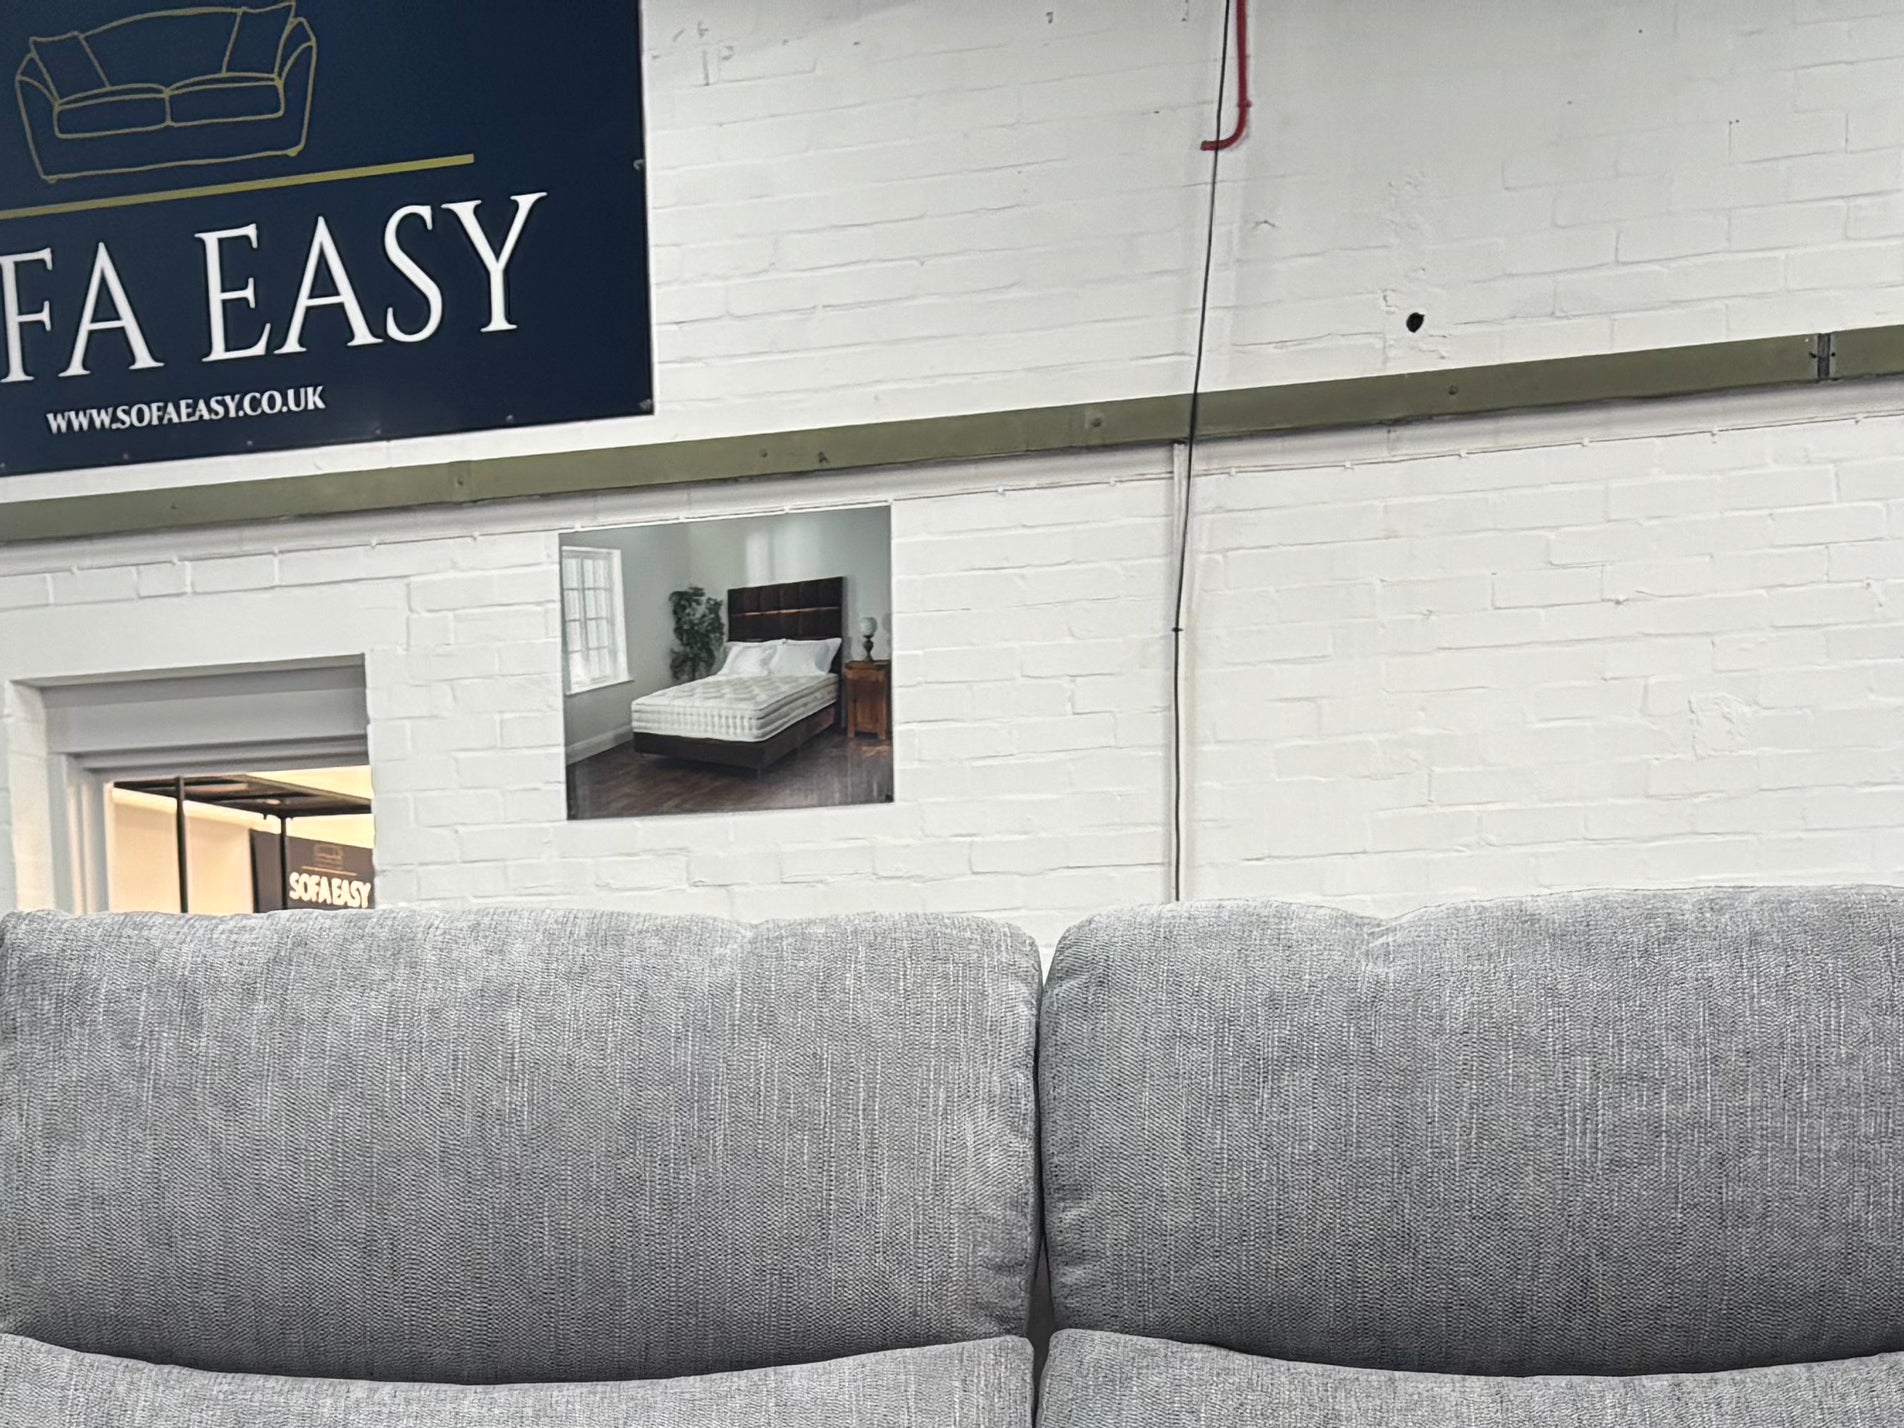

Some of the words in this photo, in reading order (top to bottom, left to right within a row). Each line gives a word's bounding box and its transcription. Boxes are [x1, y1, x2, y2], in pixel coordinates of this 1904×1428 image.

[194, 192, 547, 365] EASY
[46, 386, 326, 436] WWW.SOFAEASY.CO.UK
[289, 871, 332, 905] SOFA
[331, 877, 372, 909] EASY
